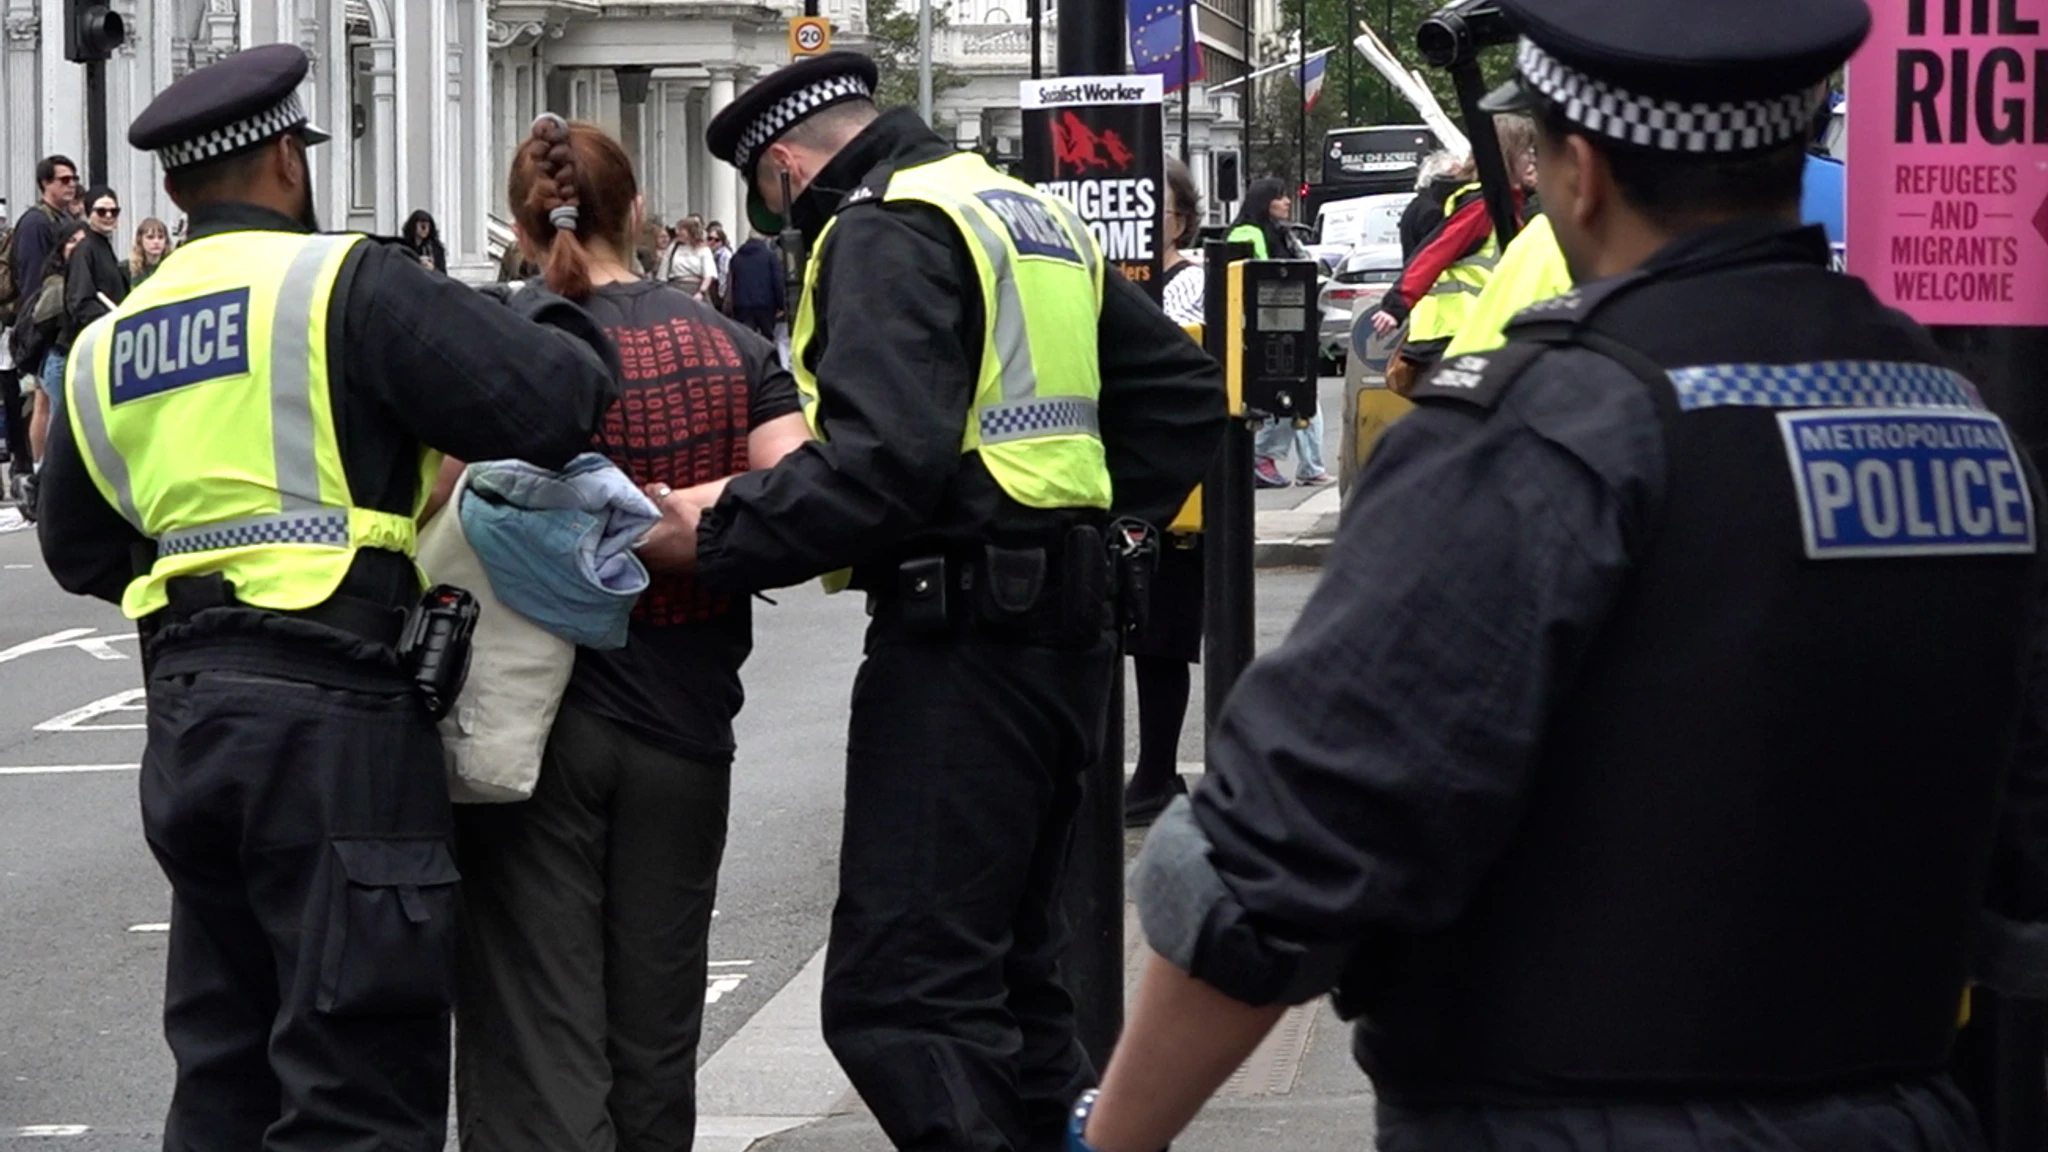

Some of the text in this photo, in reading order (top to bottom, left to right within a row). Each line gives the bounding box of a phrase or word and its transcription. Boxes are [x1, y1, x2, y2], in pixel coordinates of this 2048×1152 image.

[800, 30, 820, 43] 20
[1083, 83, 1145, 101] Worker
[1895, 47, 2048, 145] RIG
[1895, 165, 2018, 195] REFUGEES
[1930, 201, 1978, 230] AND
[1892, 236, 2018, 266] MIGRANTS
[1894, 272, 2014, 302] WELCOME
[115, 302, 241, 387] POLICE
[671, 317, 699, 369] JESUS
[686, 376, 710, 436] LOVES
[626, 389, 646, 449] LOVES
[645, 387, 667, 447] LOVES
[664, 383, 690, 442] LOVES
[1800, 423, 2007, 451] METROPOLITAN
[1807, 458, 2026, 540] POLICE
